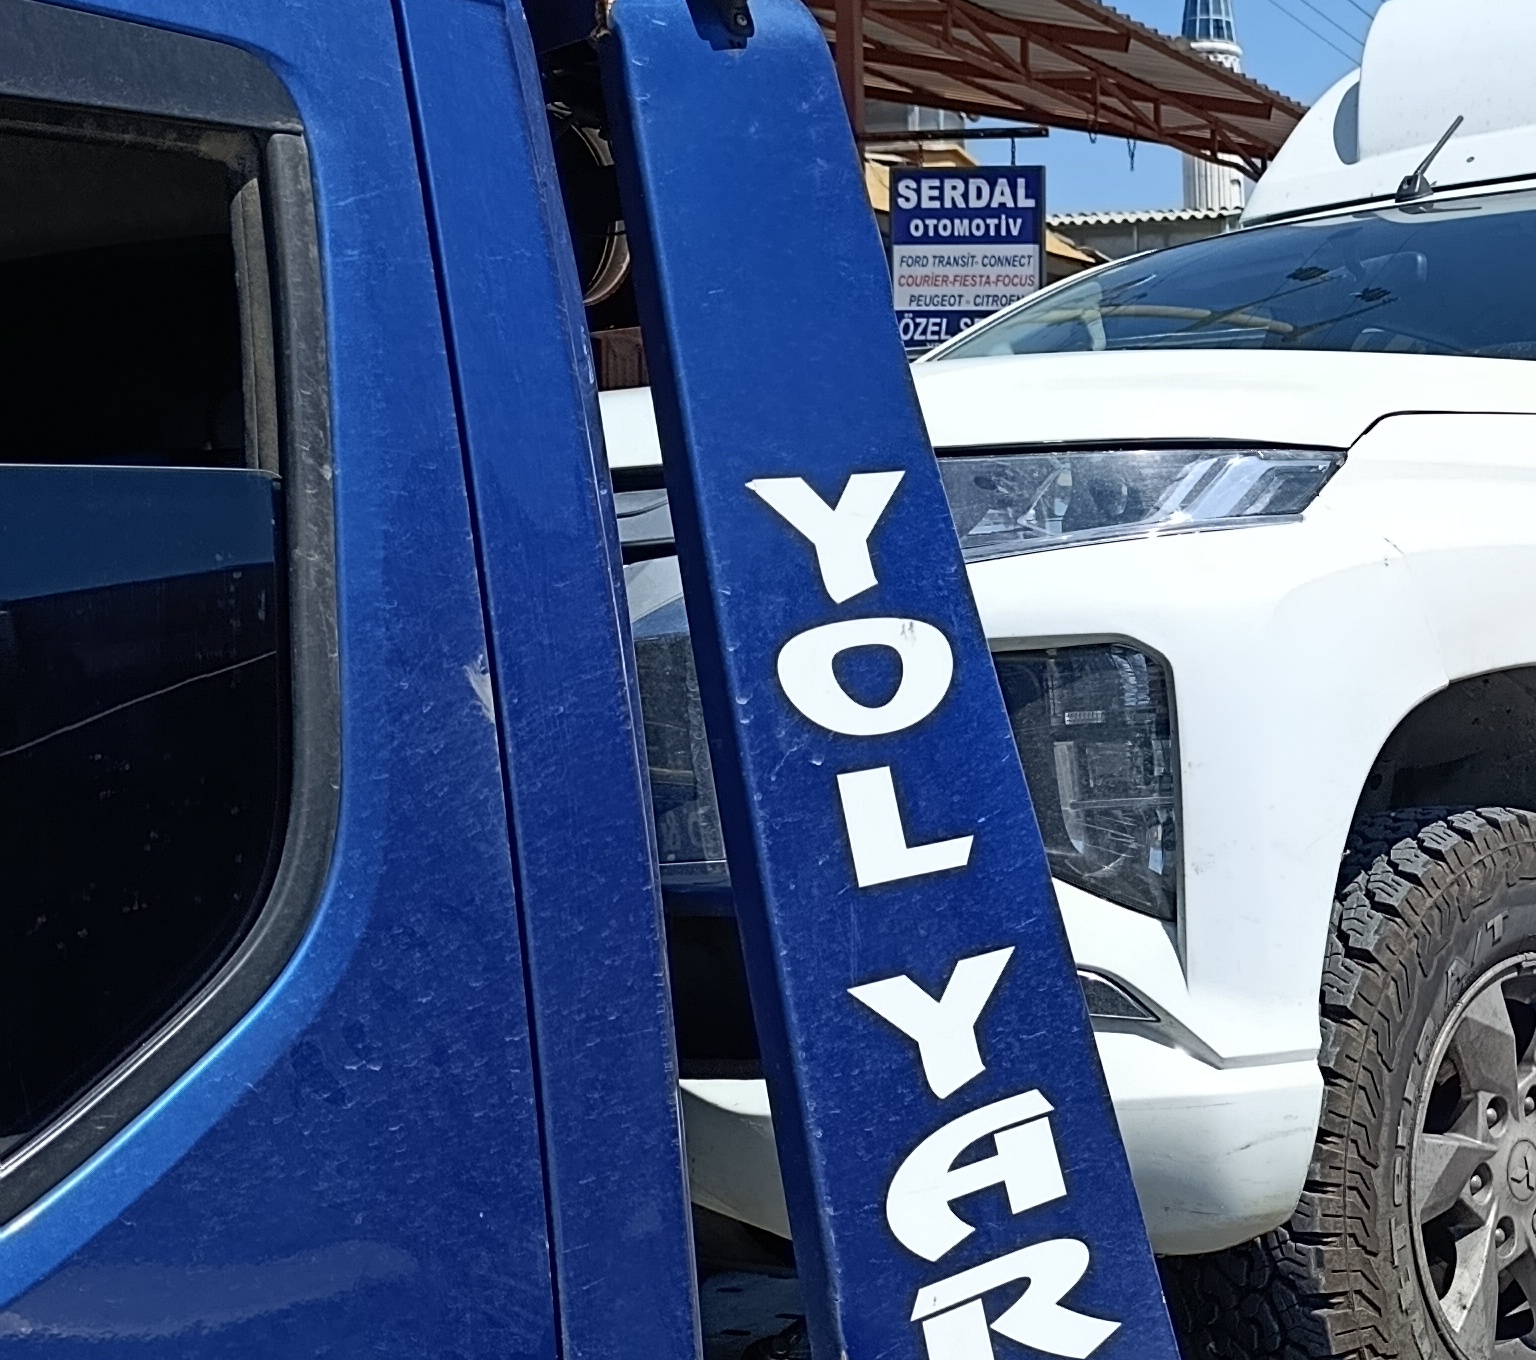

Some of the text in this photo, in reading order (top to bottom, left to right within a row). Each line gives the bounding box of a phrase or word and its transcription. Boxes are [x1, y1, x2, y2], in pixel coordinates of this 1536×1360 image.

[897, 177, 1036, 210] SERDAL
[909, 214, 1023, 238] OTOMOTİV
[900, 255, 929, 268] FORD
[981, 254, 1034, 268] CONNECT
[909, 294, 965, 308] PEUGEOT
[900, 313, 953, 341] ÖZEL
